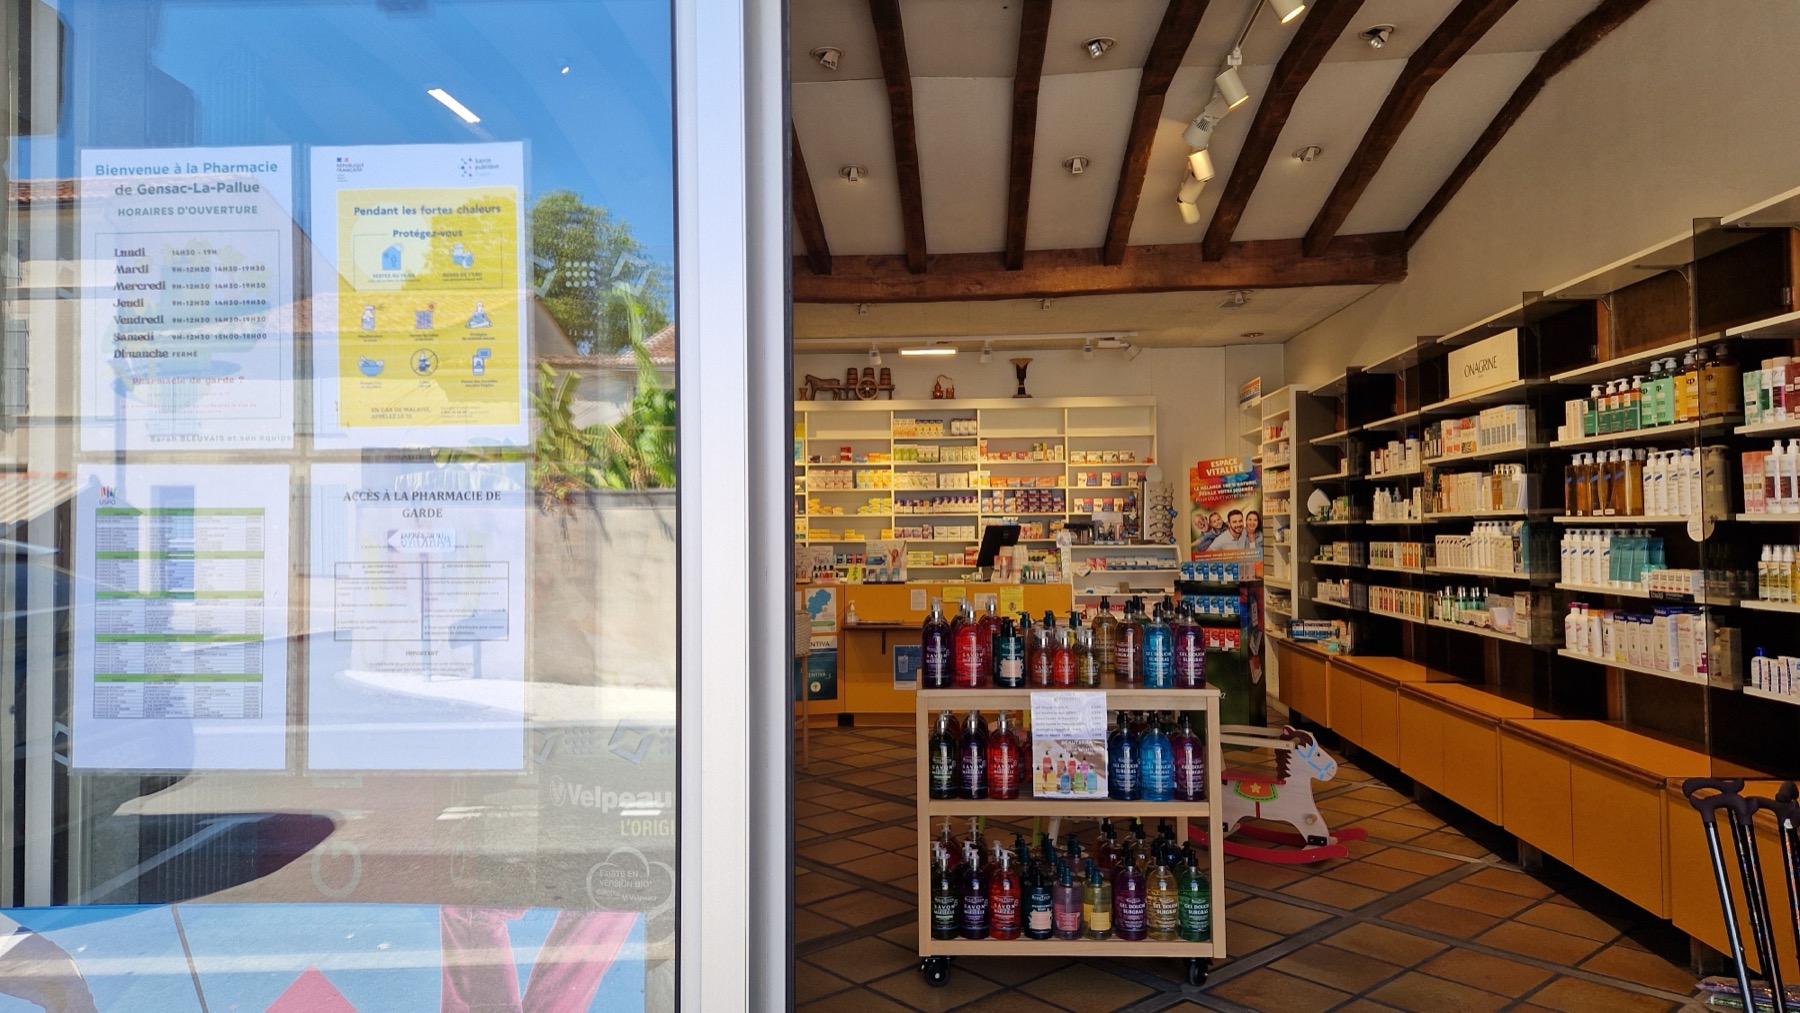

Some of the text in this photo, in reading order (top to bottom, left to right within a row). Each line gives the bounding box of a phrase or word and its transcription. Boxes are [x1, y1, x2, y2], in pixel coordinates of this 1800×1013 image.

[95, 161, 278, 176] Bienvenue à la Pharmacie
[115, 182, 260, 196] de Gensac-La-Pallue
[118, 206, 258, 217] HORAIRES D'OUVERTURE
[354, 204, 501, 216] Pendant les fortes chaleurs
[392, 228, 463, 240] Protégez-vous
[114, 248, 146, 258] Lundi
[114, 264, 149, 274] Mardi
[214, 264, 266, 272] 14H30-19H30
[113, 281, 166, 291] Mercredi
[112, 298, 144, 308] Jeudi
[112, 314, 164, 325] Vendredi
[214, 316, 267, 324] 14H30-19H30
[112, 332, 155, 342] Samedi
[113, 349, 169, 359] Dimanche
[1464, 355, 1498, 378] ONAGRINE
[132, 376, 186, 386] Pharmacie
[190, 376, 200, 384] de
[205, 376, 235, 386] garde
[150, 434, 177, 443] Sarah
[1210, 458, 1238, 468] ESPACE
[1206, 463, 1244, 476] VITALITÉ
[344, 489, 502, 501] ACCÈS À LA PHARMACIE DE
[402, 508, 443, 518] GARDE
[567, 783, 672, 814] Velpeau
[600, 870, 638, 878] EXISTE EN
[600, 880, 633, 888] VERSION
